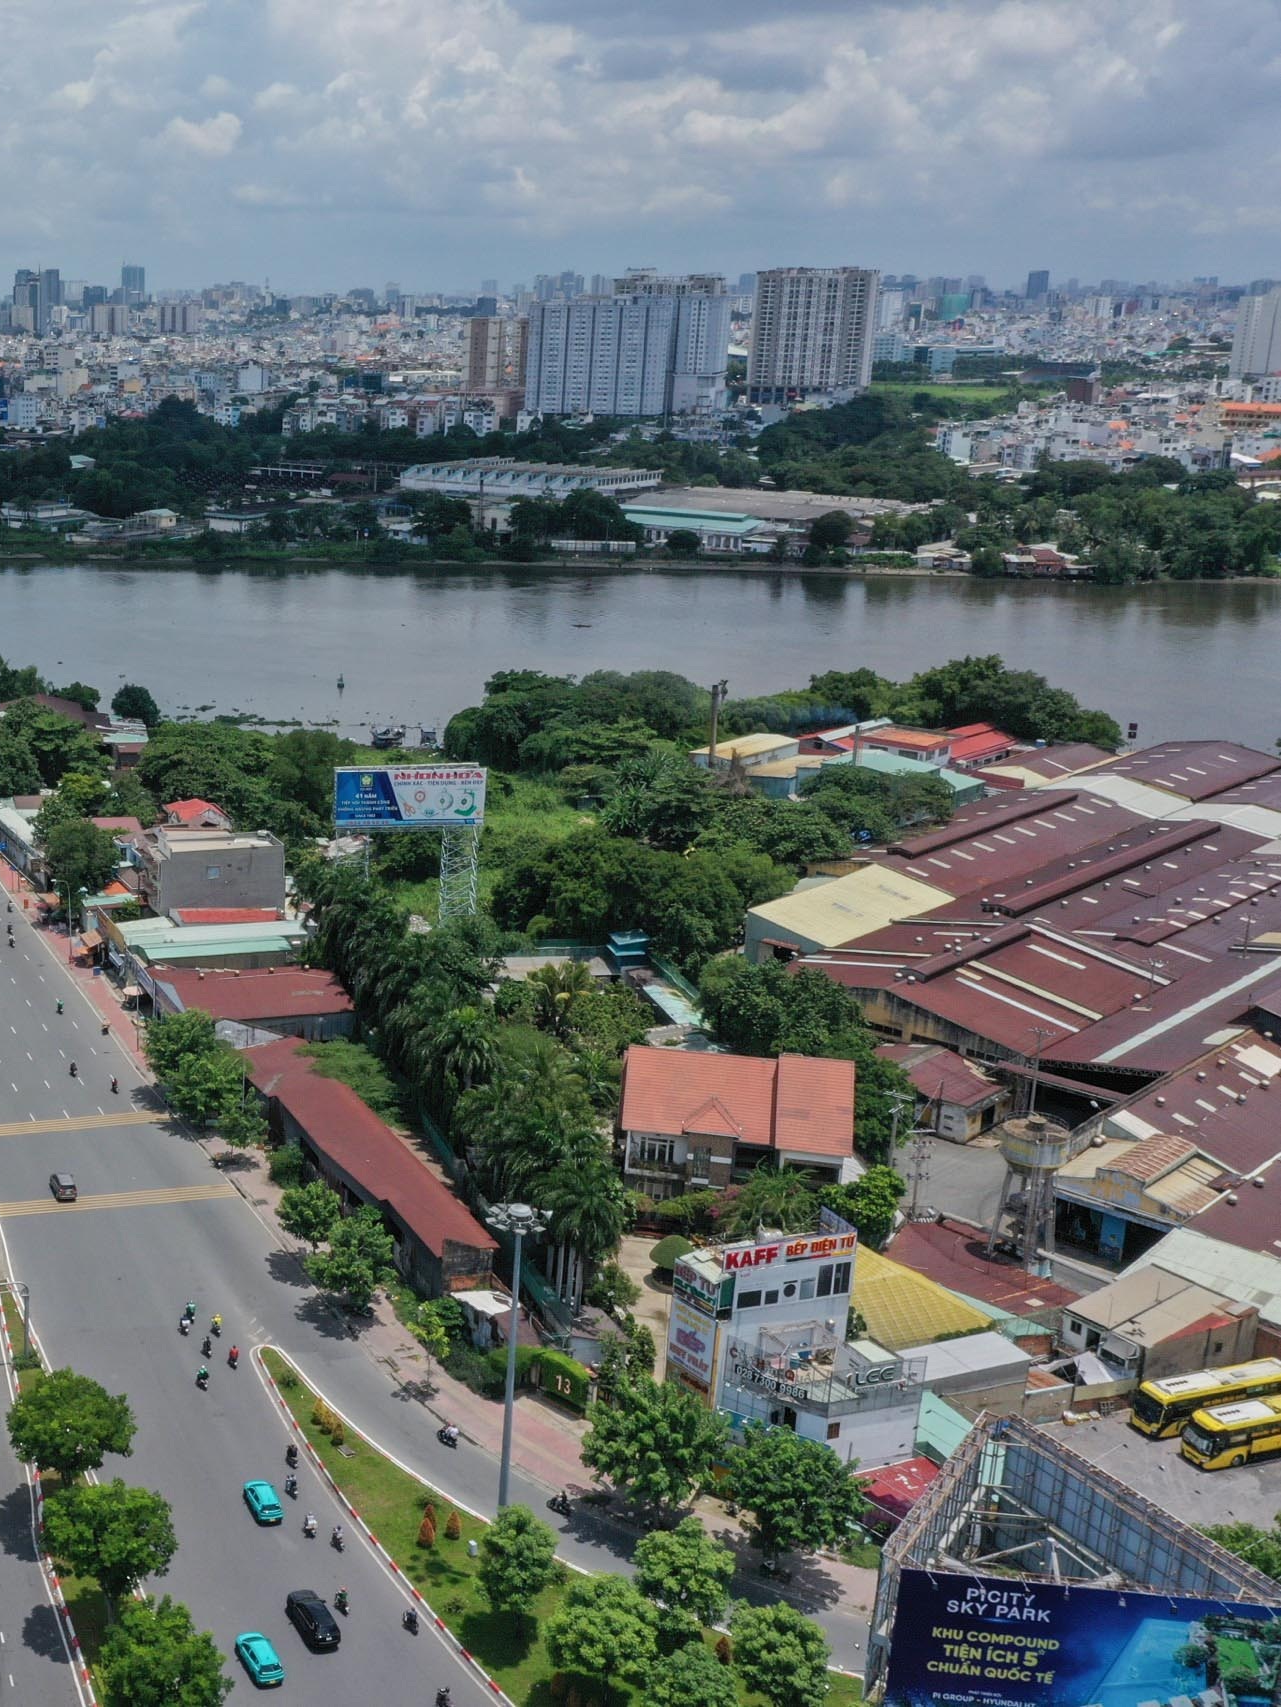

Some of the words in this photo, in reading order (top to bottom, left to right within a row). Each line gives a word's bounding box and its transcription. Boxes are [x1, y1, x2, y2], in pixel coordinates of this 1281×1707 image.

[725, 1247, 779, 1270] KAFF
[786, 1239, 809, 1257] BẾP
[555, 1375, 571, 1395] 13
[736, 1366, 752, 1380] 028
[754, 1373, 777, 1390] 7300
[779, 1383, 805, 1399] 9986
[946, 1600, 988, 1616] SKY
[995, 1606, 1052, 1623] PARK
[932, 1626, 964, 1641] KHU
[966, 1631, 1060, 1651] COMPOUND
[943, 1643, 982, 1663] TIỆN
[986, 1645, 1019, 1664] ÍCH
[1023, 1651, 1039, 1667] 5
[984, 1666, 1032, 1682] QUỐC
[1035, 1670, 1056, 1685] TẾ
[942, 1693, 975, 1702] GROUP
[982, 1698, 1022, 1707] HYUNDAI
